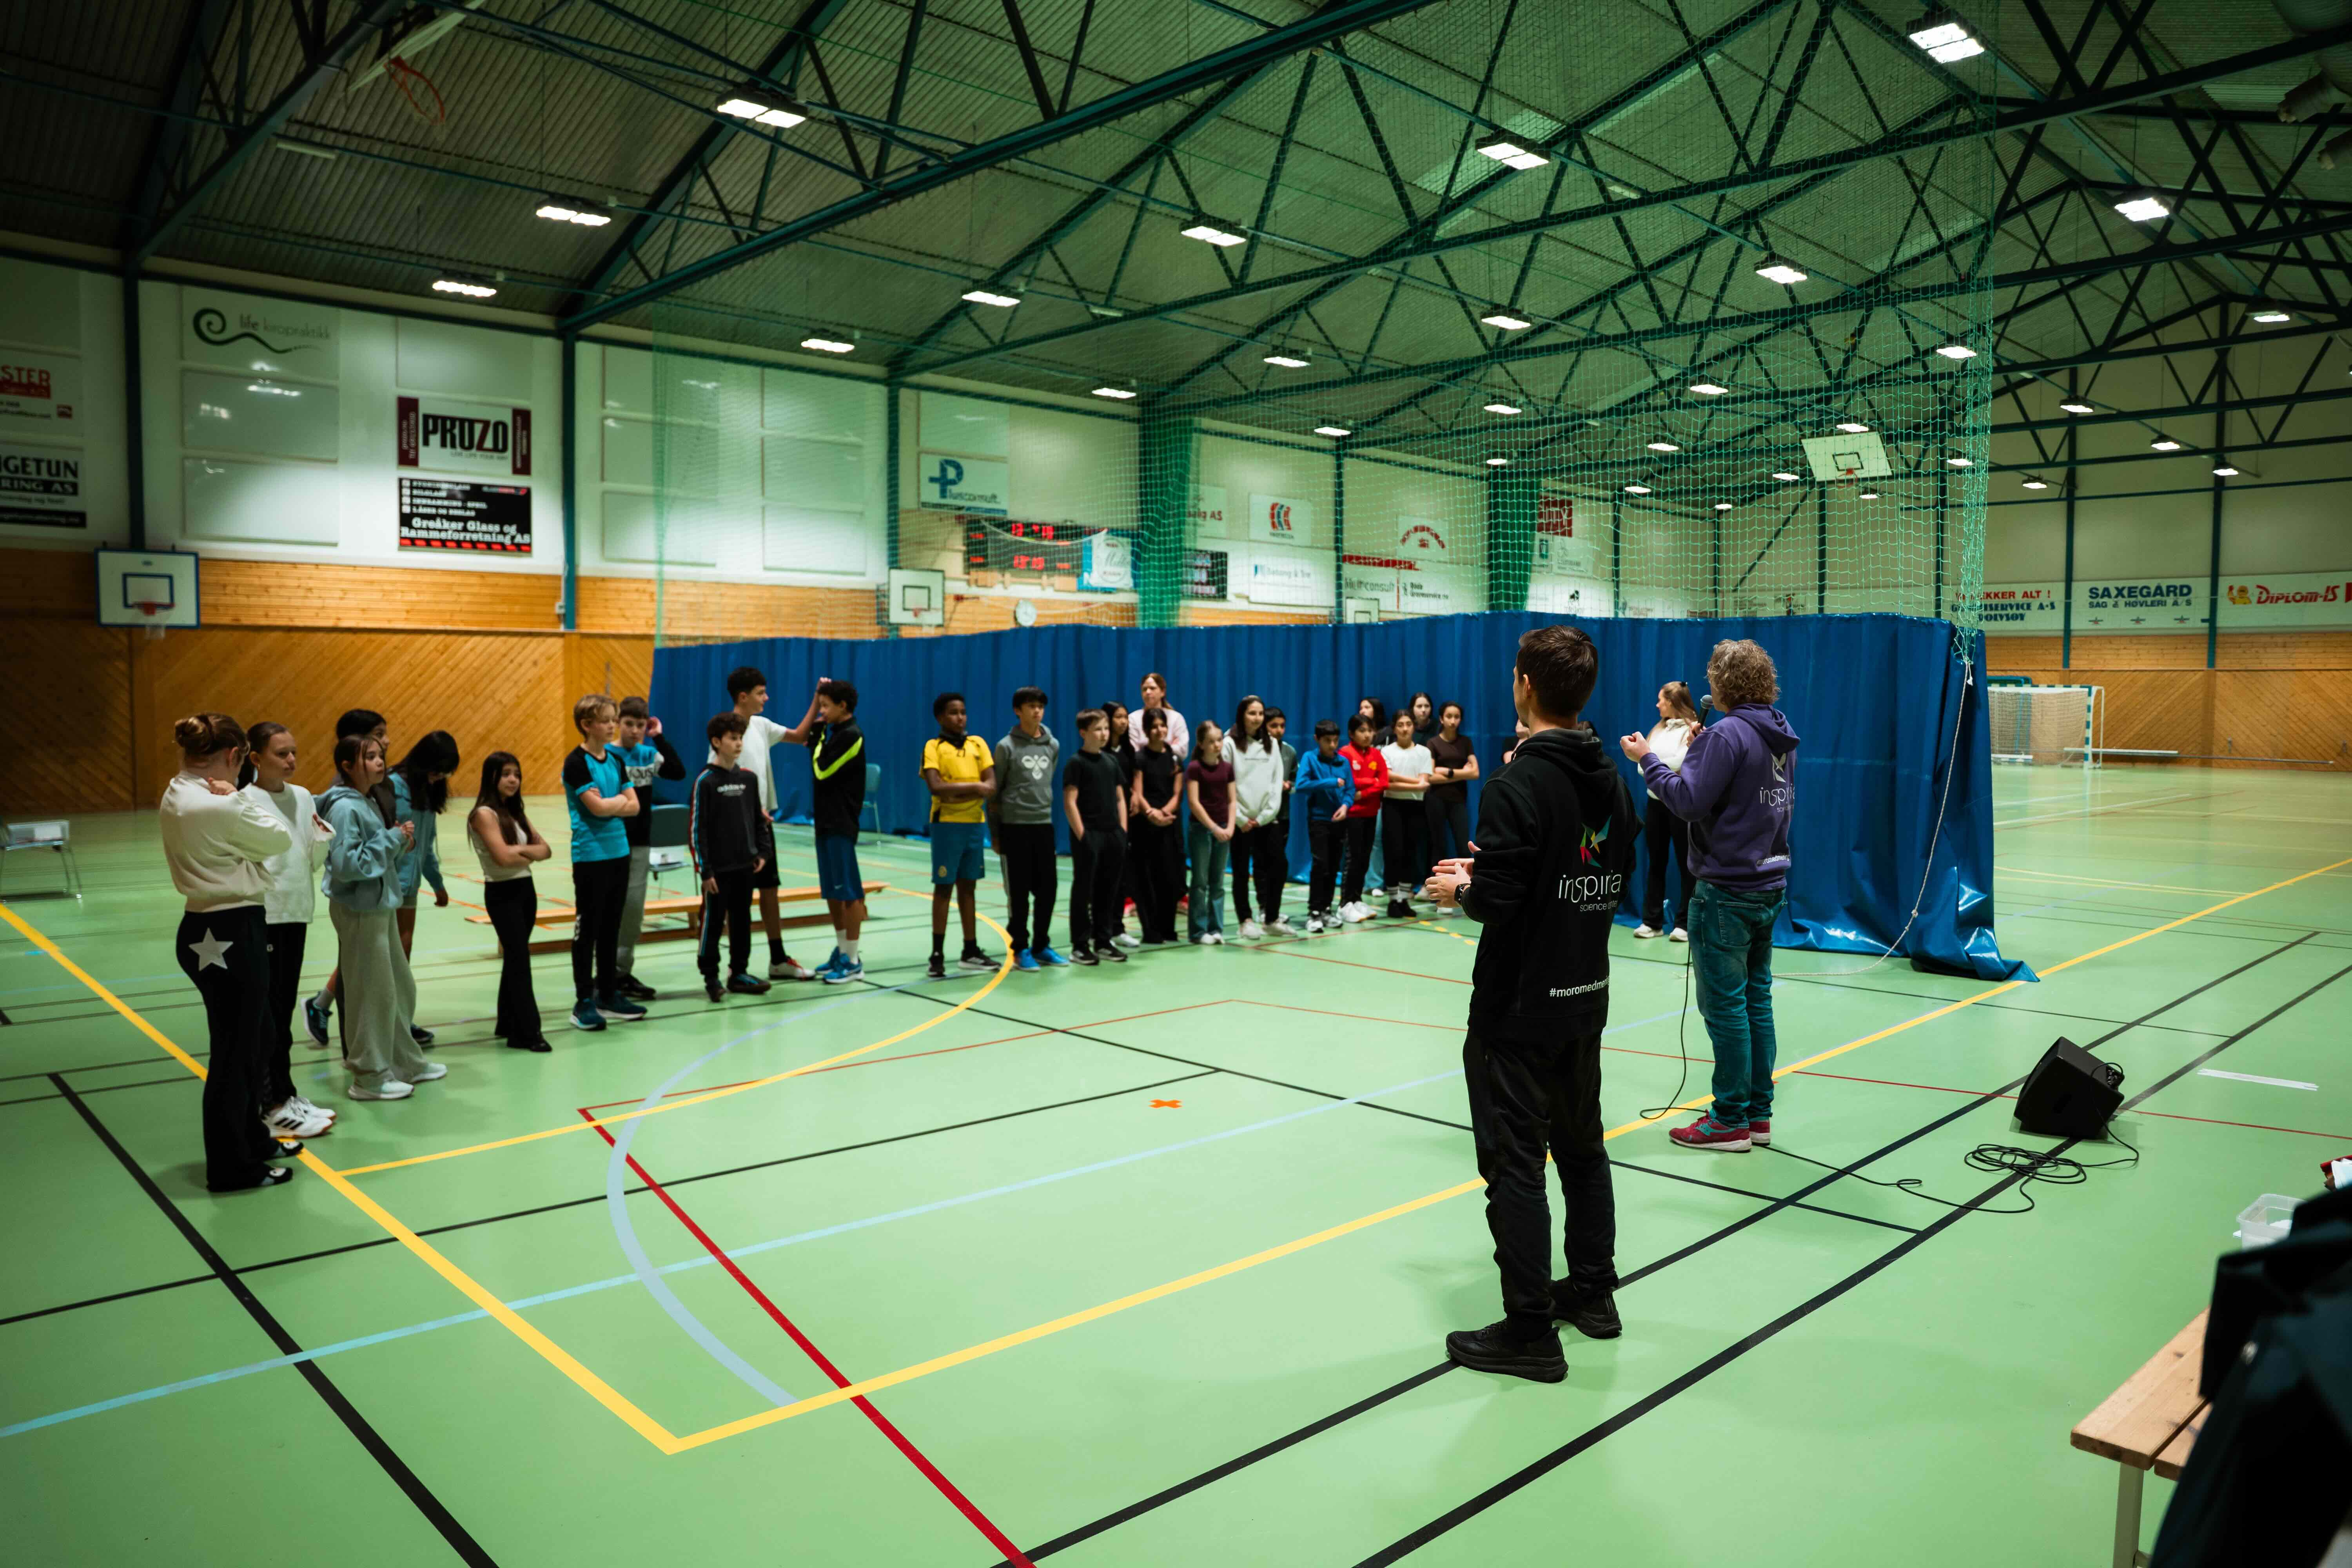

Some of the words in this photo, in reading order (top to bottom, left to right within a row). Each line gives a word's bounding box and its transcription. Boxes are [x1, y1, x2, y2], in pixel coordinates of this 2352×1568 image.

[240, 313, 259, 331] life
[0, 456, 78, 478] GETUN
[51, 482, 74, 492] AS
[412, 517, 463, 530] Greåker
[466, 520, 500, 533] Glass
[503, 524, 517, 535] og
[401, 526, 512, 545] Rammeforretning
[514, 534, 530, 544] AS
[2021, 590, 2042, 599] ALT
[2089, 583, 2192, 599] SAXEGÅRD
[2124, 599, 2166, 608] HØVLERI
[1580, 903, 1607, 912] science
